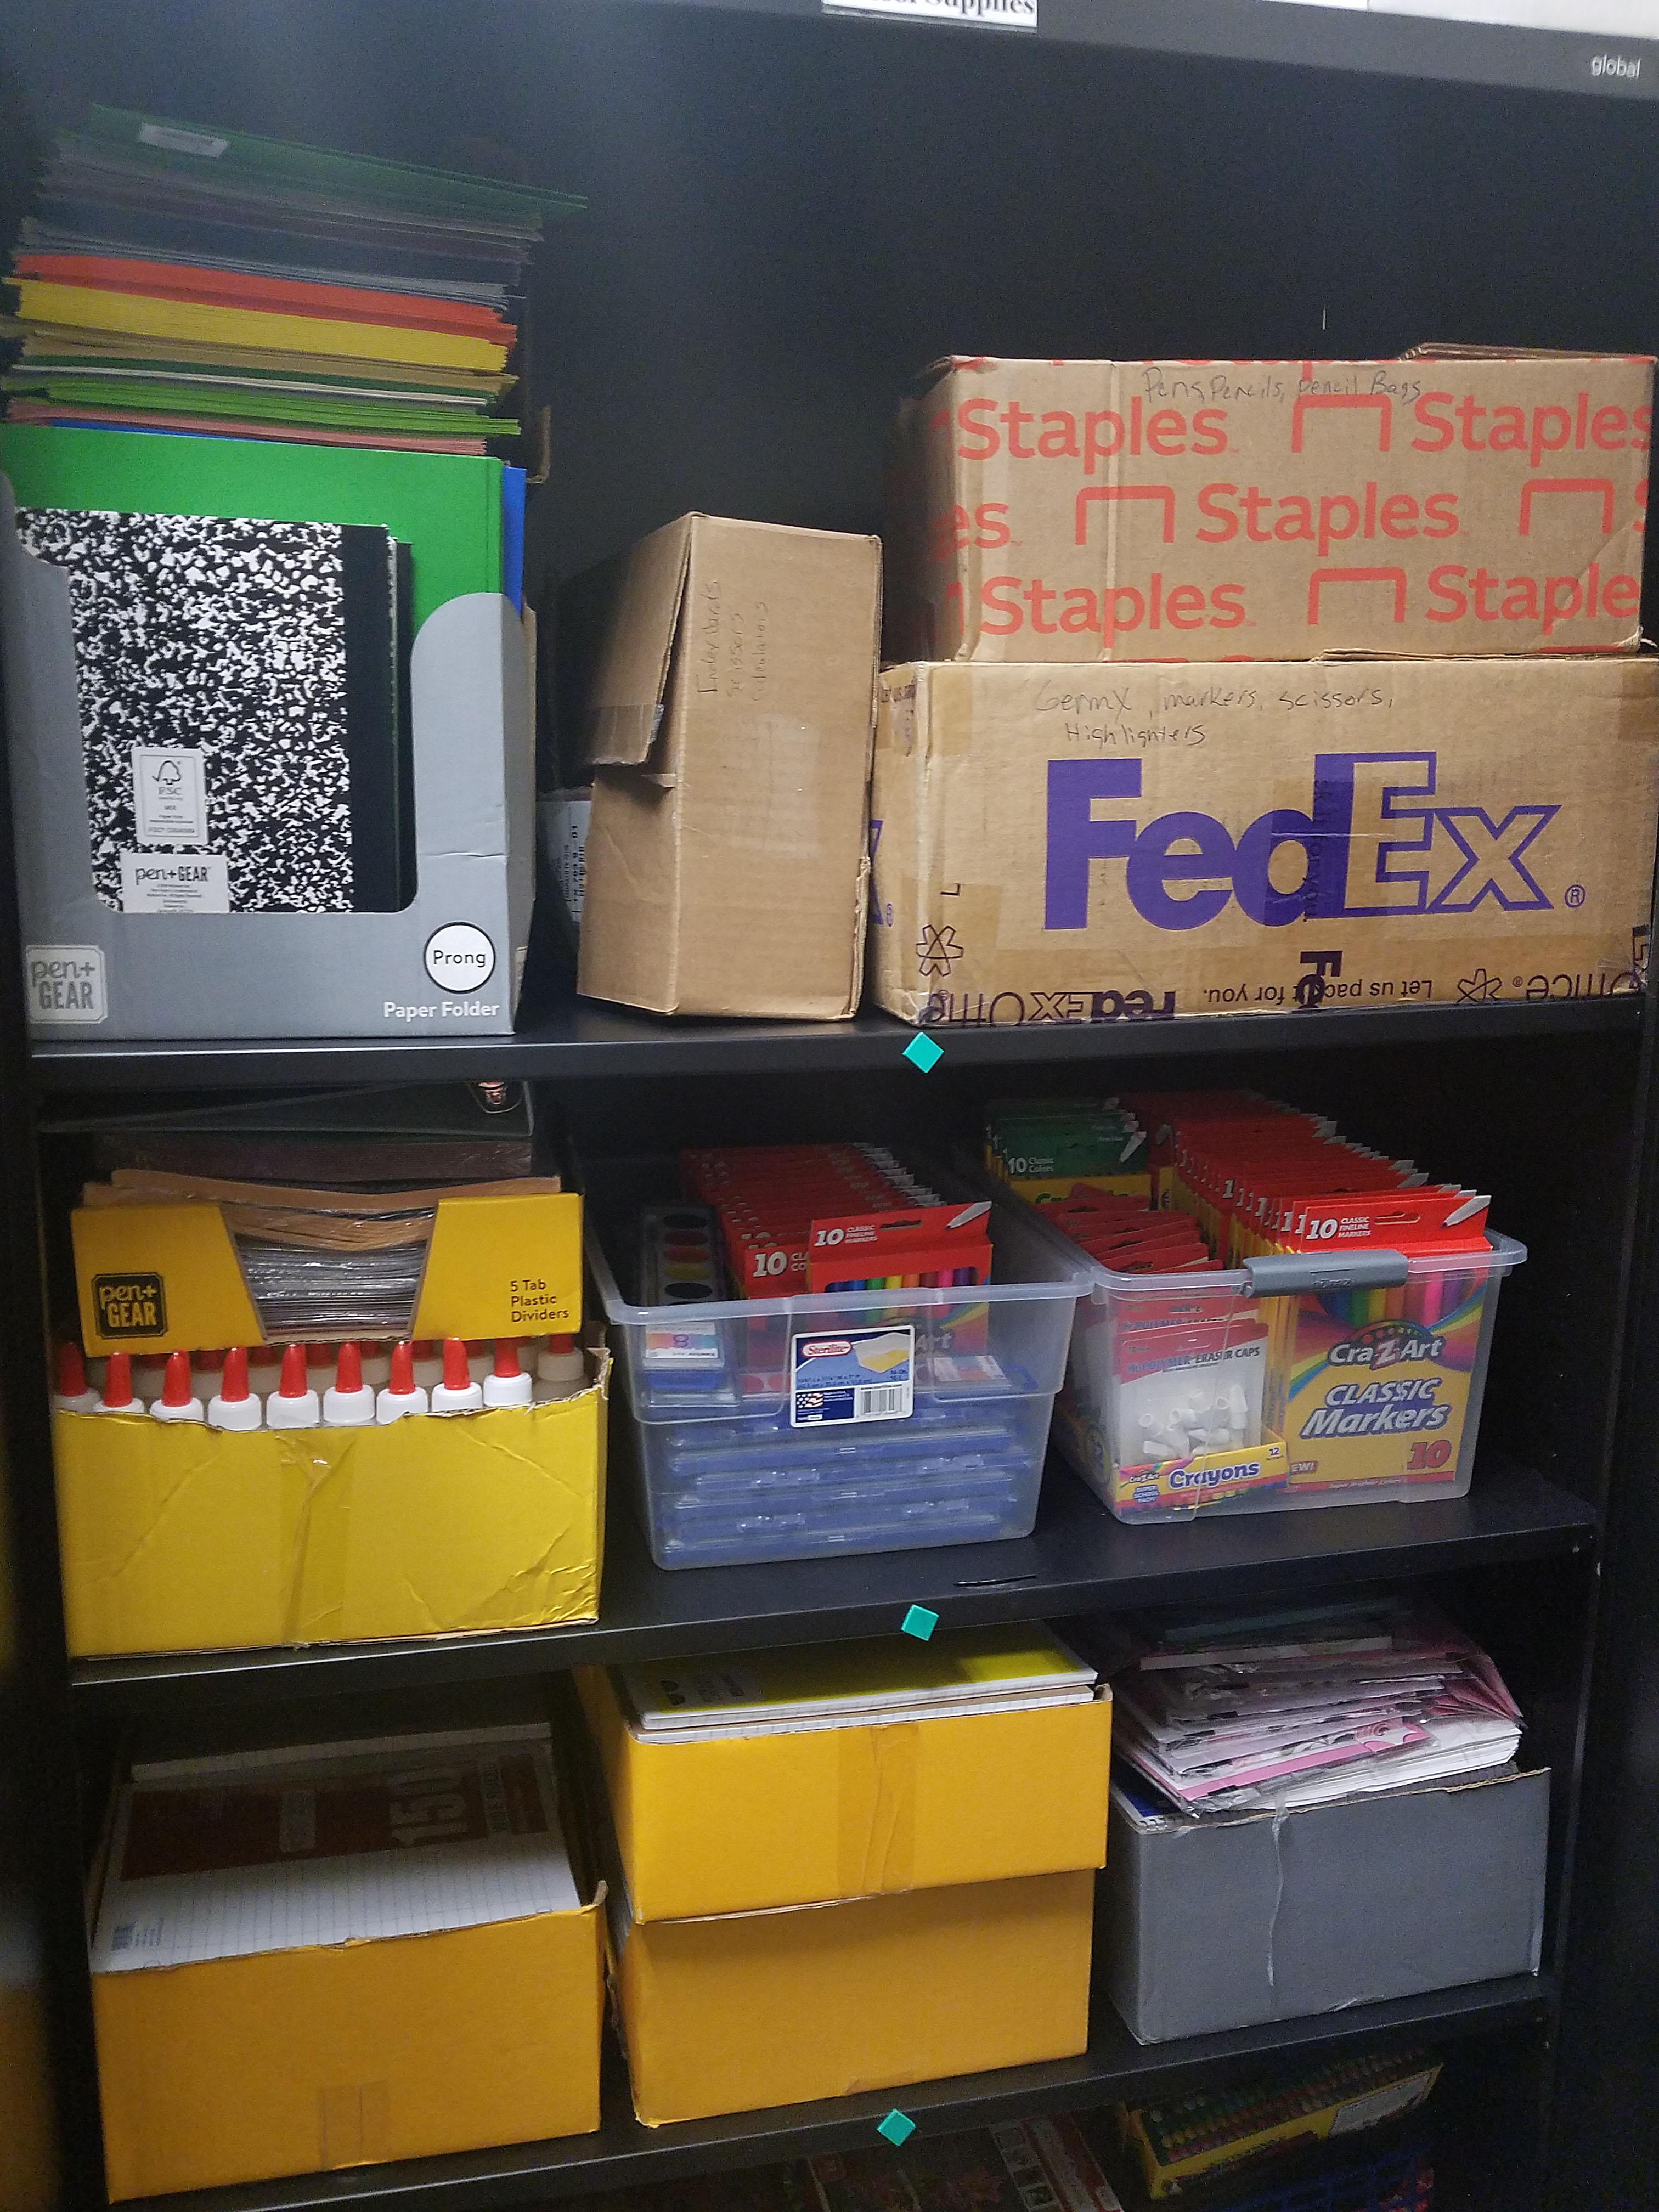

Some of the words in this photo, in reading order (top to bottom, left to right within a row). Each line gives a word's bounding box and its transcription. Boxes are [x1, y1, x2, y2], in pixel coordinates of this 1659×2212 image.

[1591, 53, 1641, 79] global
[958, 396, 1229, 475] Staples
[1411, 391, 1653, 467] Staples
[1197, 481, 1460, 557] Staples
[980, 572, 1247, 648] Staples
[1425, 562, 1640, 635] Staple
[1043, 751, 1563, 930] FedEx
[433, 950, 486, 968] Prong
[39, 981, 94, 1009] GEAR
[1252, 985, 1285, 1006] for
[1369, 981, 1394, 997] us
[1401, 980, 1433, 999] Let
[383, 1001, 437, 1023] Paper
[441, 1000, 500, 1017] Folder
[1007, 1157, 1028, 1174] 10
[814, 1228, 845, 1246] 10
[1306, 1218, 1338, 1240] 10
[1338, 1230, 1372, 1238] MARKERS
[753, 1251, 788, 1278] 10
[510, 1280, 518, 1292] 5
[522, 1279, 546, 1291] Tab
[511, 1293, 557, 1307] Plastic
[107, 1302, 157, 1327] GEAR
[512, 1308, 569, 1322] Dividers
[1235, 1346, 1260, 1358] CAPS
[1325, 1378, 1441, 1406] CLASSIC
[1301, 1404, 1449, 1436] Markers
[1269, 1447, 1279, 1456] 12
[1407, 1439, 1452, 1470] 10
[1170, 1462, 1259, 1487] Crayons
[1291, 1462, 1316, 1474] EW!
